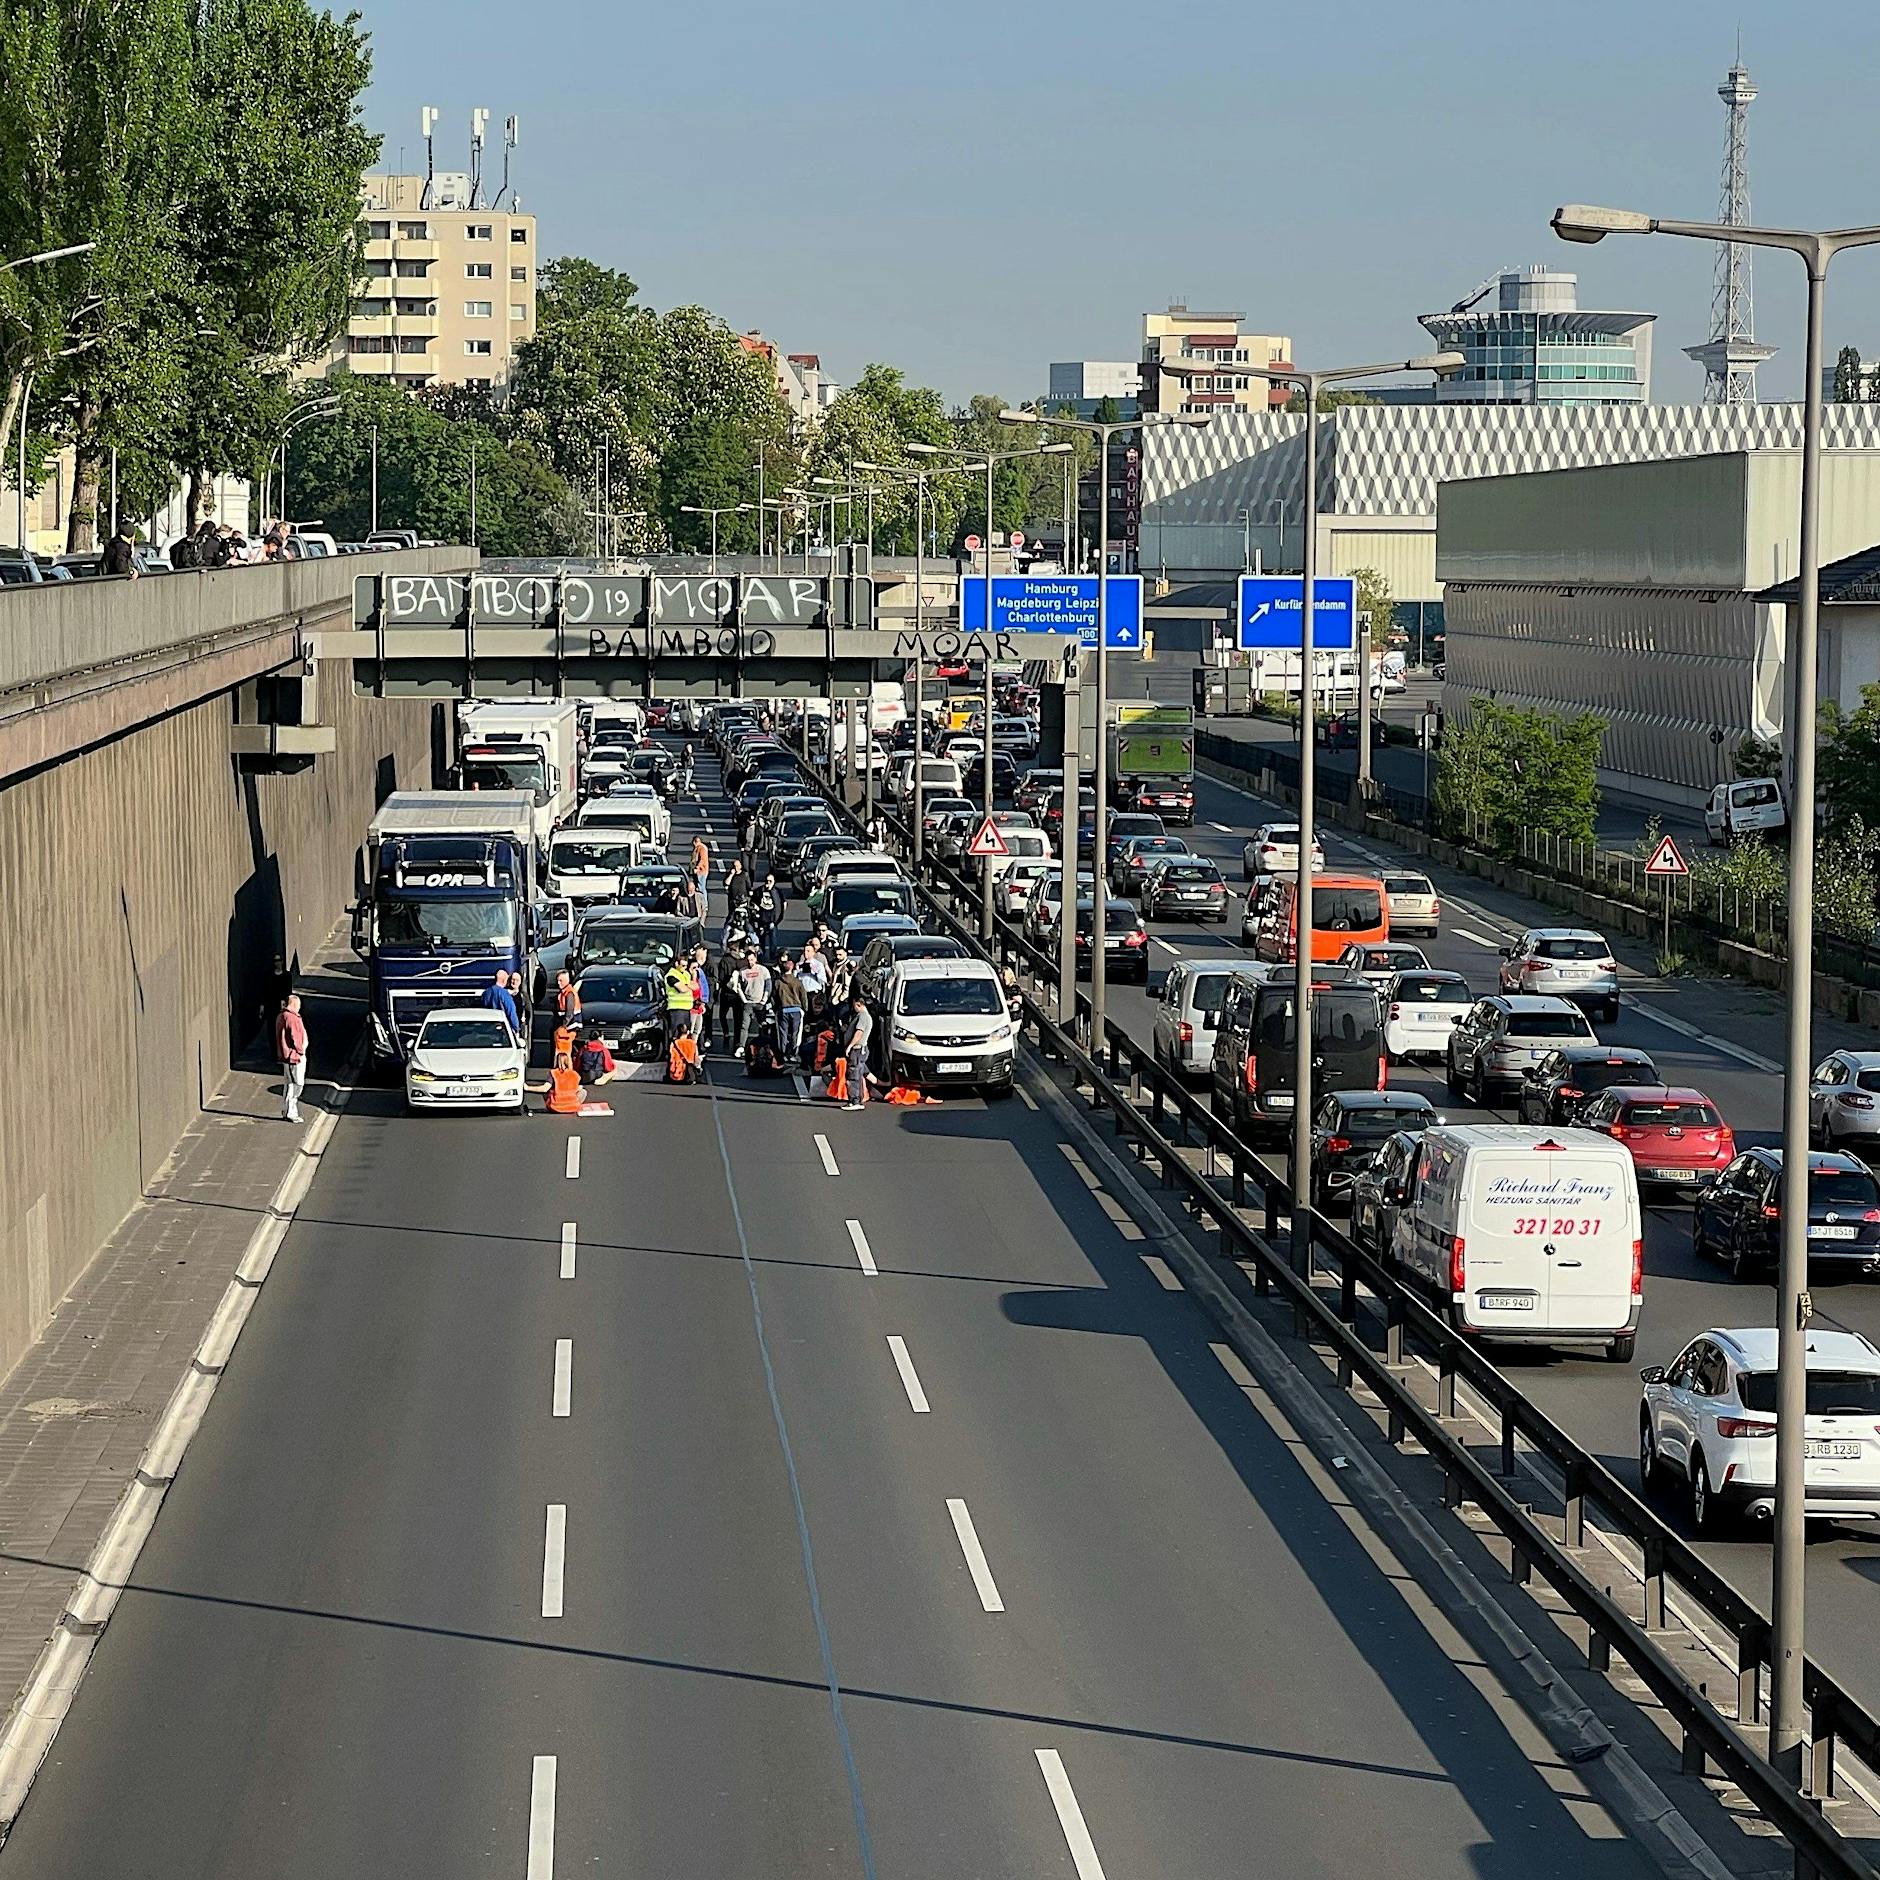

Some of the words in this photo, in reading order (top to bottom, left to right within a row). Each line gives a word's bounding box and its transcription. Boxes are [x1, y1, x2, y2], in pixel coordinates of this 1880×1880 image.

[1126, 456, 1136, 550] BAUHAUS
[1110, 556, 1117, 565] P
[1025, 583, 1078, 595] Hamburg
[655, 578, 822, 622] MOAR
[997, 598, 1061, 610] Magdeburg
[1066, 598, 1099, 610] Leipzi
[1008, 612, 1094, 625] Charlottenburg
[1081, 630, 1095, 638] 100
[893, 632, 1018, 659] MOAR
[426, 874, 464, 887] OPR
[1489, 1177, 1561, 1193] Richard
[1563, 1178, 1614, 1201] Franz
[1513, 1218, 1547, 1235] 321
[1552, 1219, 1575, 1235] 20
[1579, 1219, 1601, 1235] 31
[1512, 1299, 1529, 1307] 940
[1817, 1445, 1831, 1454] RB
[1833, 1445, 1859, 1454] 1230
